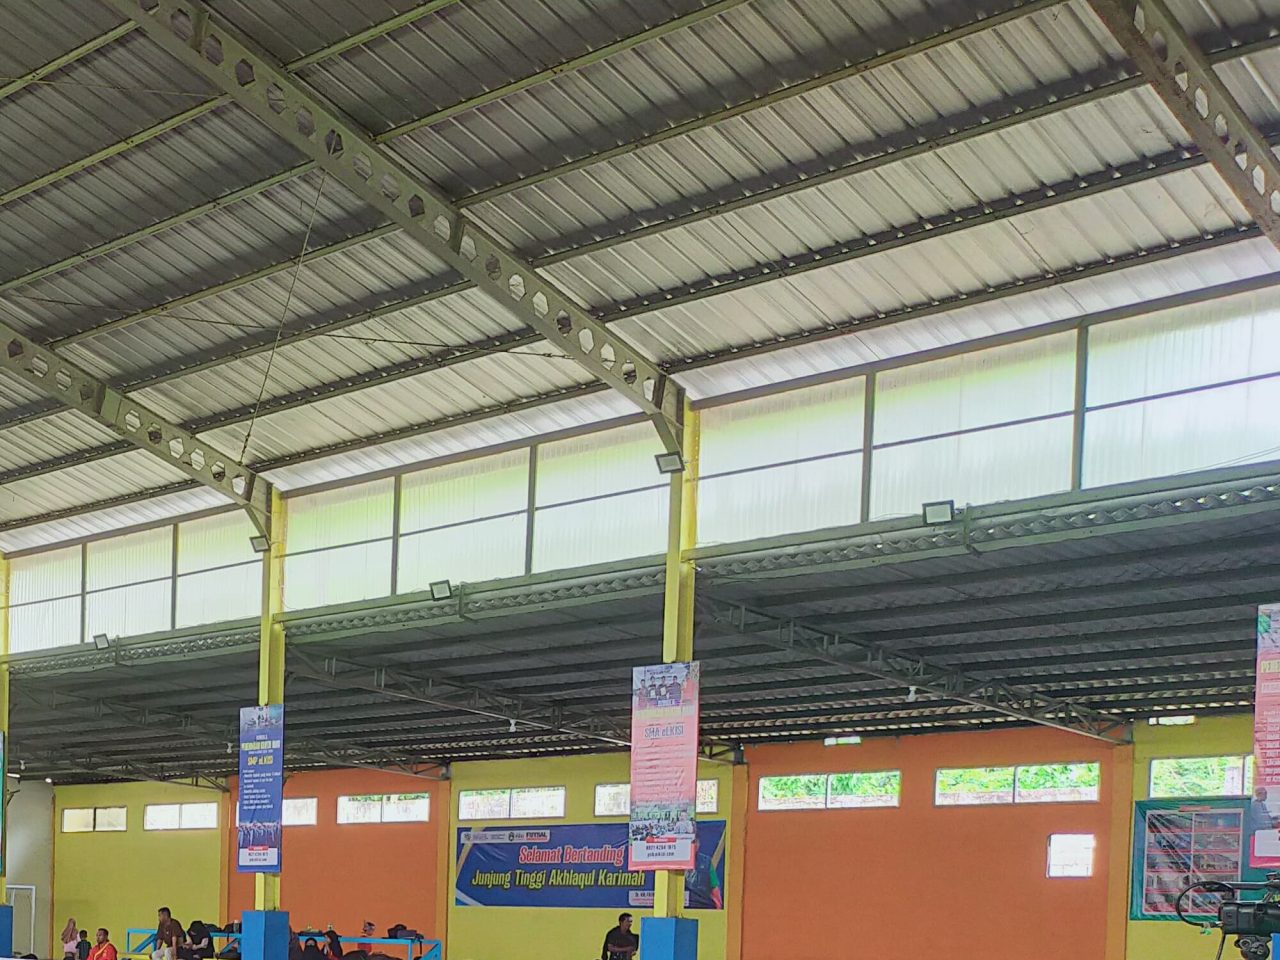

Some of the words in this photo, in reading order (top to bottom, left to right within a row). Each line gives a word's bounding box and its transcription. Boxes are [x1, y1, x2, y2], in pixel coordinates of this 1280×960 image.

[644, 727, 660, 738] SMA
[519, 845, 562, 864] Selamat
[563, 845, 624, 866] Bertanding
[472, 869, 512, 889] Junjung
[515, 869, 547, 889] Tinggi
[549, 869, 596, 889] Akhlaqul
[598, 869, 645, 886] Karimah
